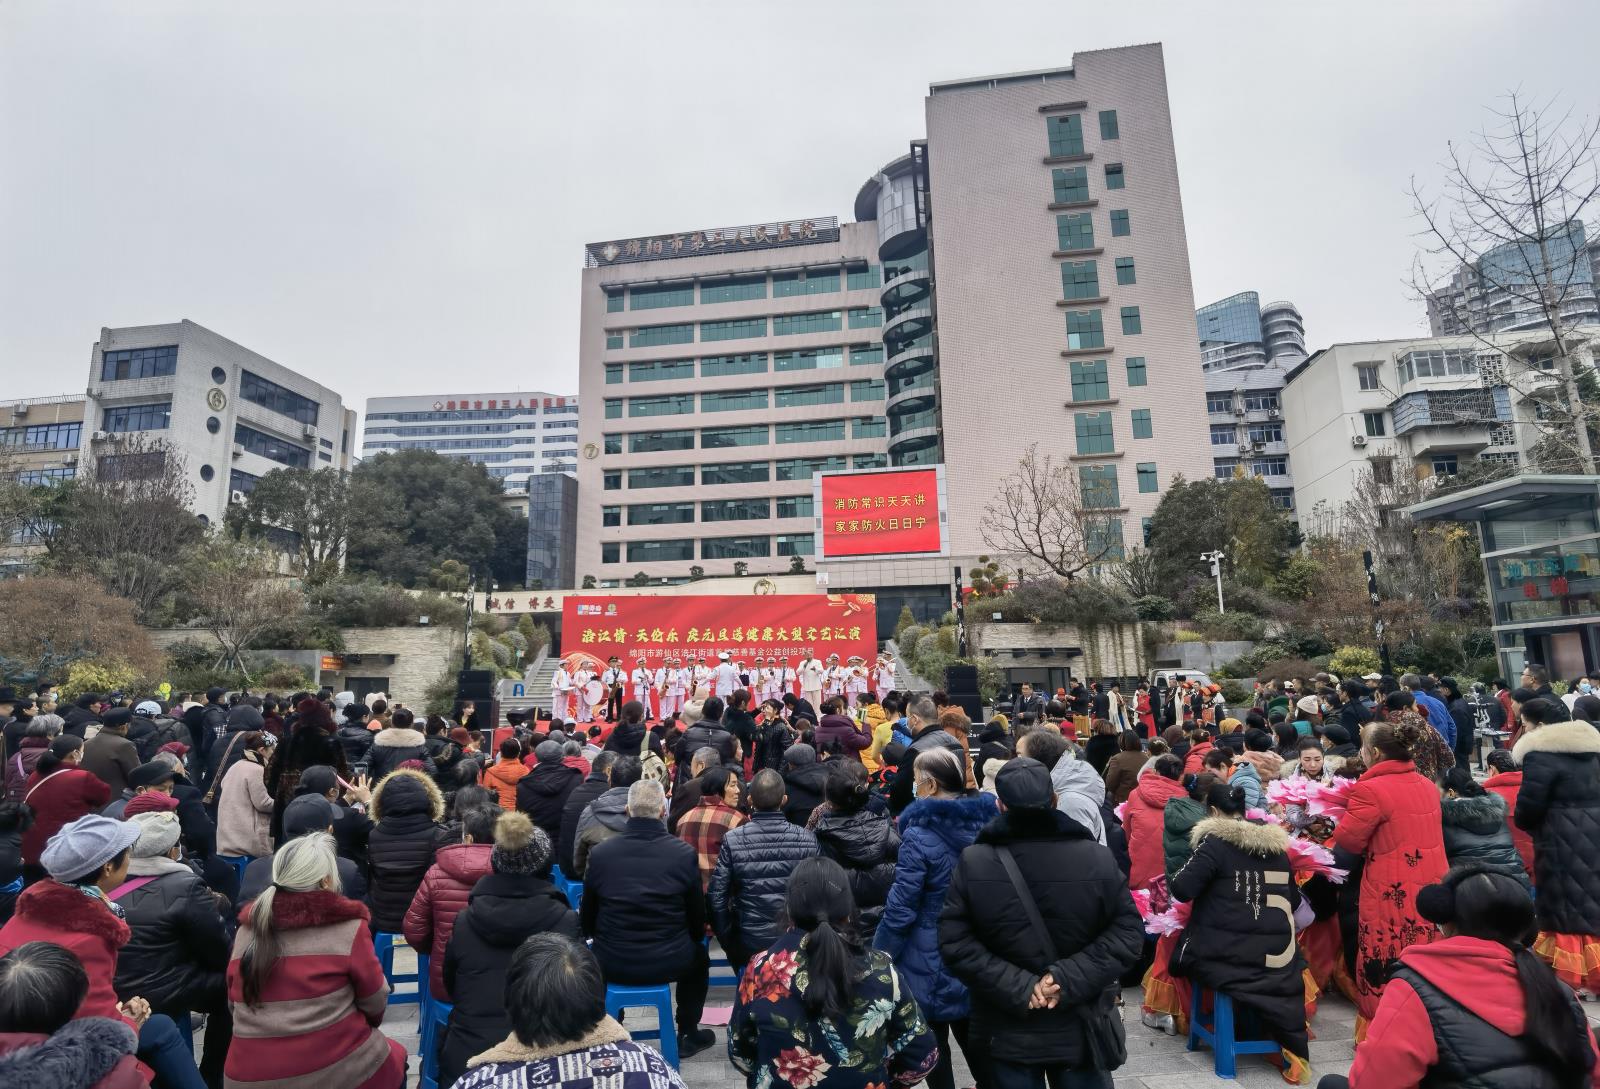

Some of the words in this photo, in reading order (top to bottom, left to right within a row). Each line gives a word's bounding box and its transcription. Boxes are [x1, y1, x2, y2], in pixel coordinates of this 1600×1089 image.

[625, 221, 818, 257] 绵阳市第三人民医院
[835, 494, 926, 510] 消防常识天天讲
[835, 517, 926, 532] 家家防火日日宁
[1263, 870, 1296, 969] 5
